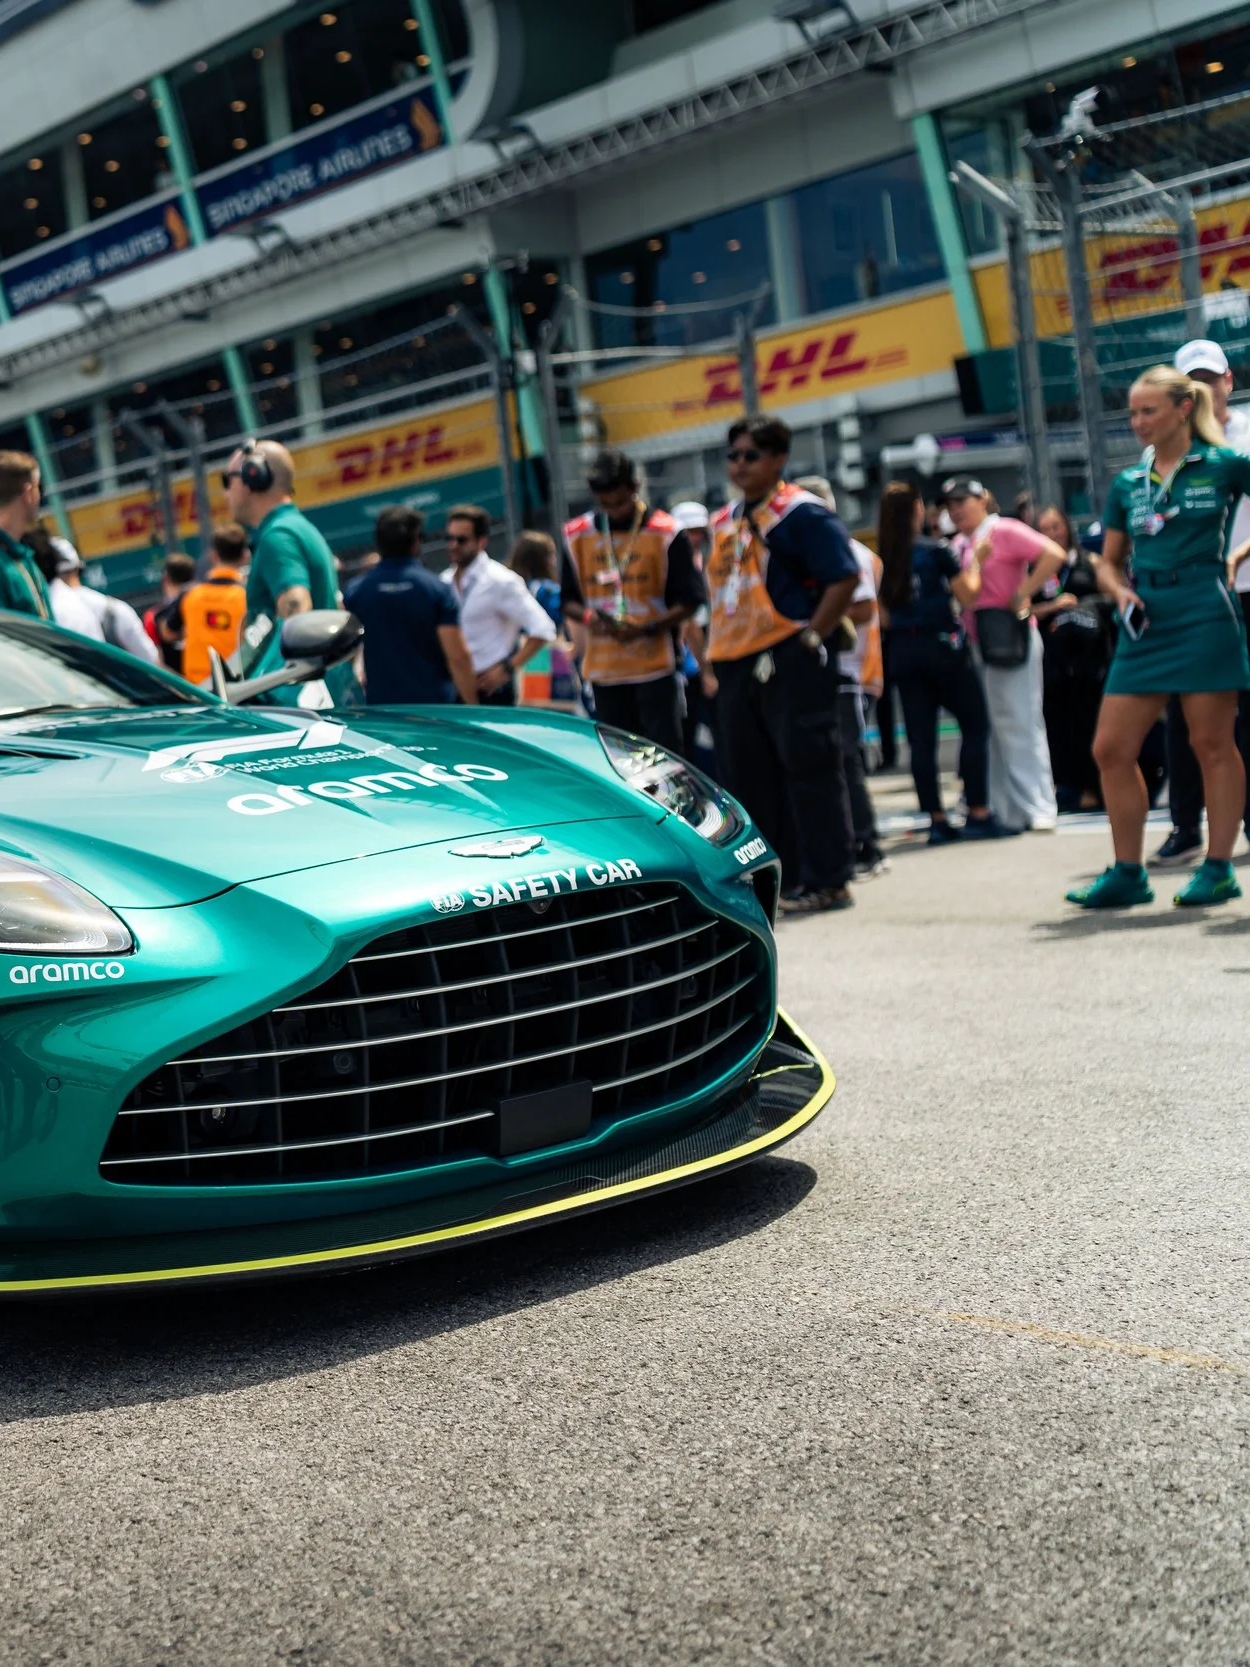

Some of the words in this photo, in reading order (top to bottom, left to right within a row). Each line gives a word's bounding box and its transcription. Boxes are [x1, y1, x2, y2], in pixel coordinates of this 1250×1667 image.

[205, 162, 317, 228] SINGAPORE
[318, 123, 412, 183] AIRLINES
[704, 331, 868, 408] DHL
[334, 424, 458, 484] DHL
[226, 763, 509, 816] aramco
[734, 837, 767, 865] aramco
[431, 892, 466, 914] FIA
[472, 867, 580, 908] SAFETY
[586, 858, 643, 885] CAR
[10, 961, 125, 984] aramco
